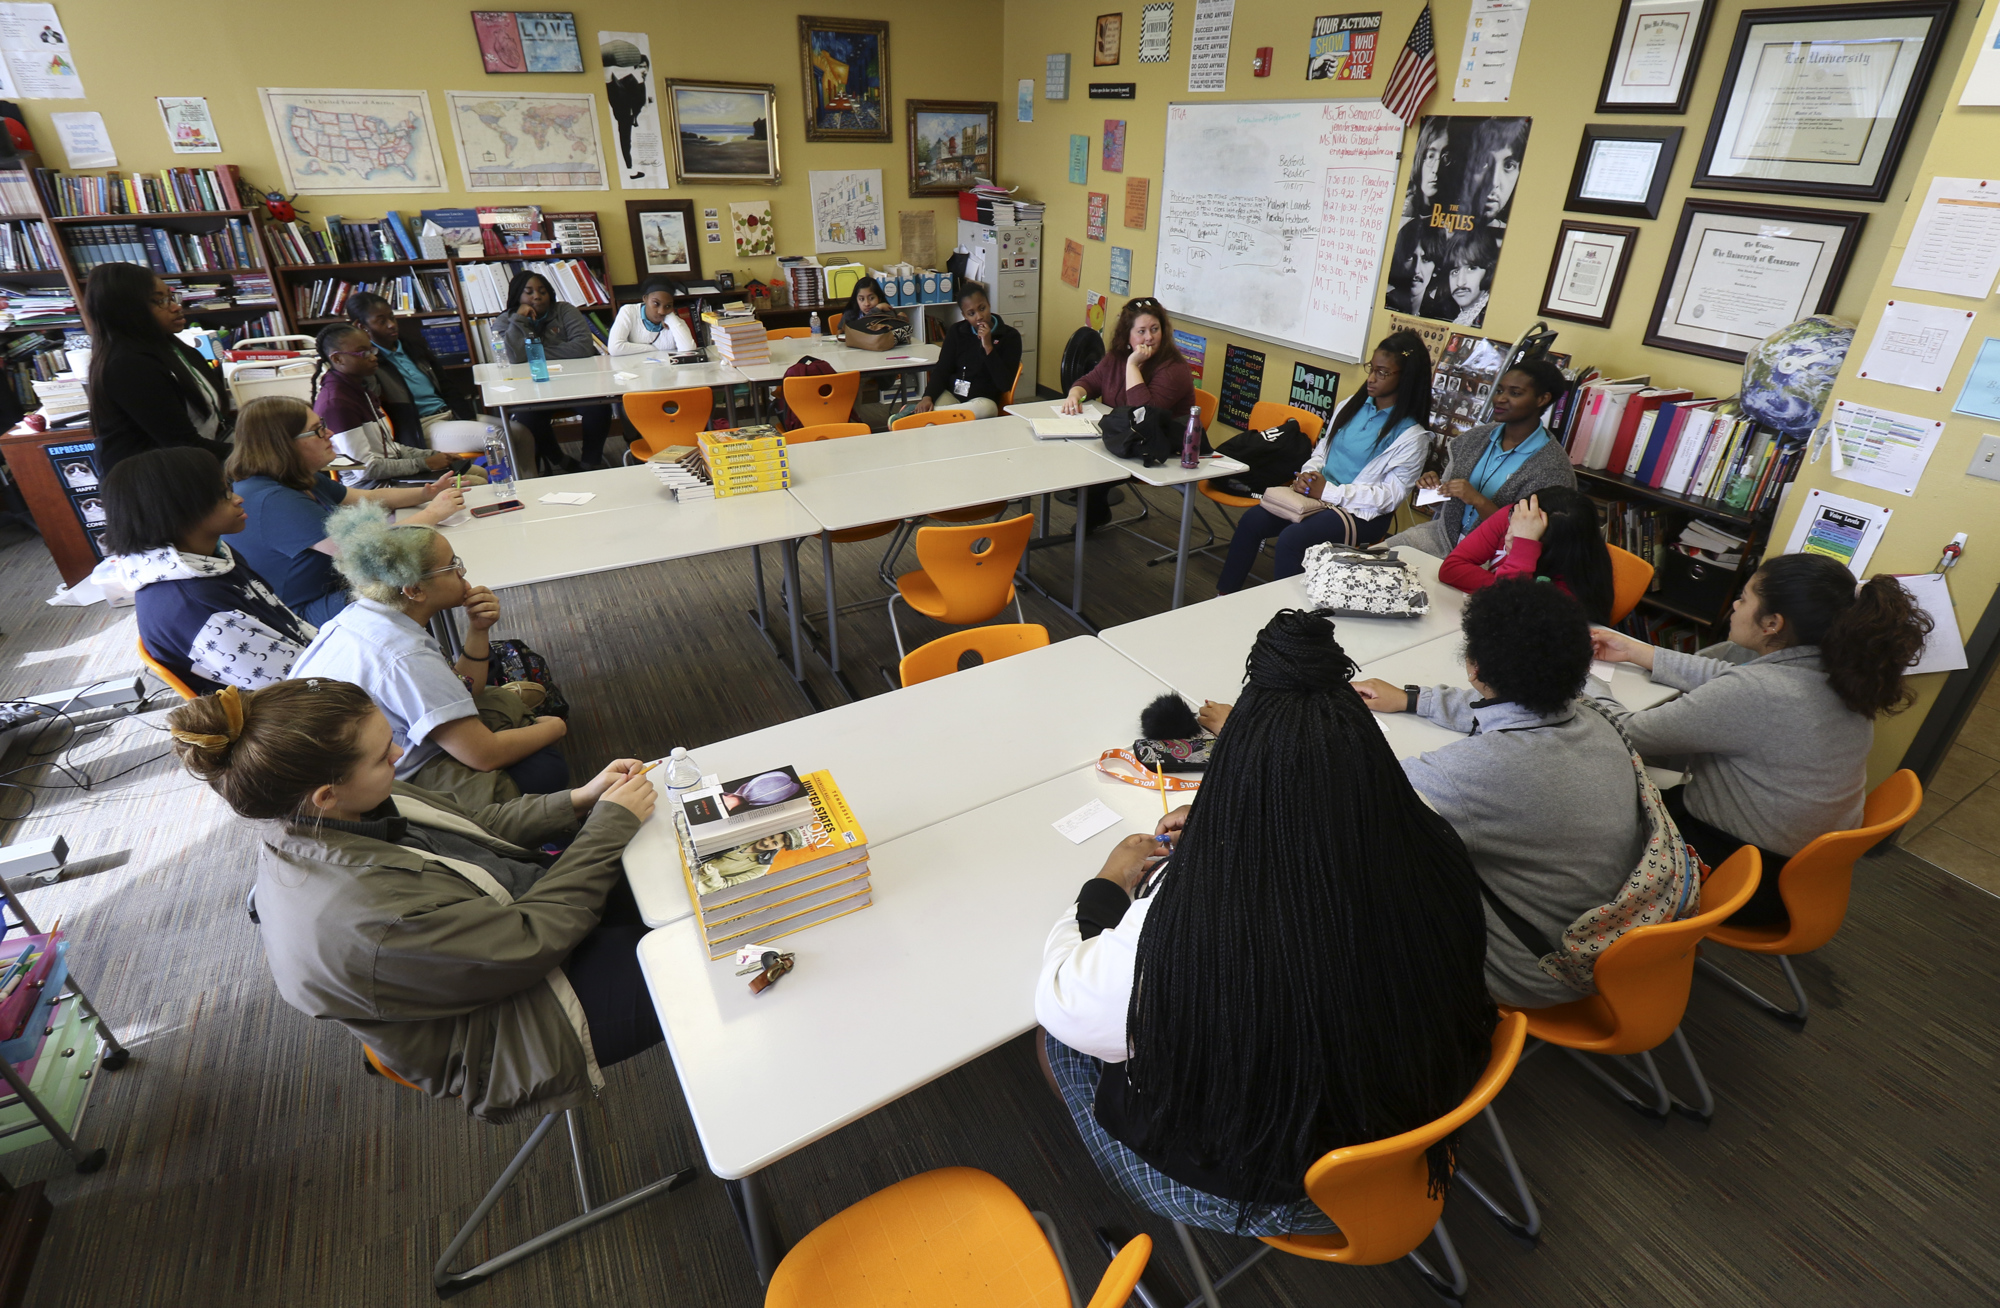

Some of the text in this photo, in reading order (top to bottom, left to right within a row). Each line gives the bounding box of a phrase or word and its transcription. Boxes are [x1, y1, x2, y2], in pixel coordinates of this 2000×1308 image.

[520, 22, 577, 38] LOVE
[1316, 16, 1380, 36] YOUR ACTIONS
[1355, 34, 1374, 50] WHO
[1472, 32, 1480, 42] H
[1316, 34, 1344, 55] SHOW
[1352, 50, 1374, 64] YOU
[1471, 47, 1477, 56] I
[1785, 52, 1871, 66] Lee University
[1350, 64, 1368, 79] ARE
[1462, 78, 1471, 88] K
[1333, 105, 1347, 120] Jen
[1332, 134, 1348, 146] Nikki
[1283, 168, 1310, 178] Reader
[1092, 197, 1102, 206] DARE
[1090, 217, 1102, 227] YOUR
[1362, 231, 1377, 244] PBL
[1357, 246, 1376, 257] Lunch
[1713, 248, 1725, 257] The
[1726, 250, 1758, 262] University
[1768, 255, 1800, 267] Tennessee
[1355, 286, 1361, 300] F
[1314, 298, 1358, 323] W is different
[1227, 348, 1234, 357] 30
[1232, 365, 1249, 376] shoes
[1246, 361, 1262, 370] matter
[1294, 365, 1336, 392] Don't
[1230, 381, 1241, 390] jeans
[1291, 386, 1332, 409] make
[48, 443, 96, 455] EXPRESSIO
[730, 466, 757, 474] HISTORY
[732, 476, 758, 484] HISTORY
[732, 486, 758, 494] HISTORY
[1829, 511, 1860, 525] Voice Levels
[1120, 751, 1136, 765] VOLS
[802, 780, 836, 834] UNITED STATES
[832, 790, 853, 824] TENNESSEE
